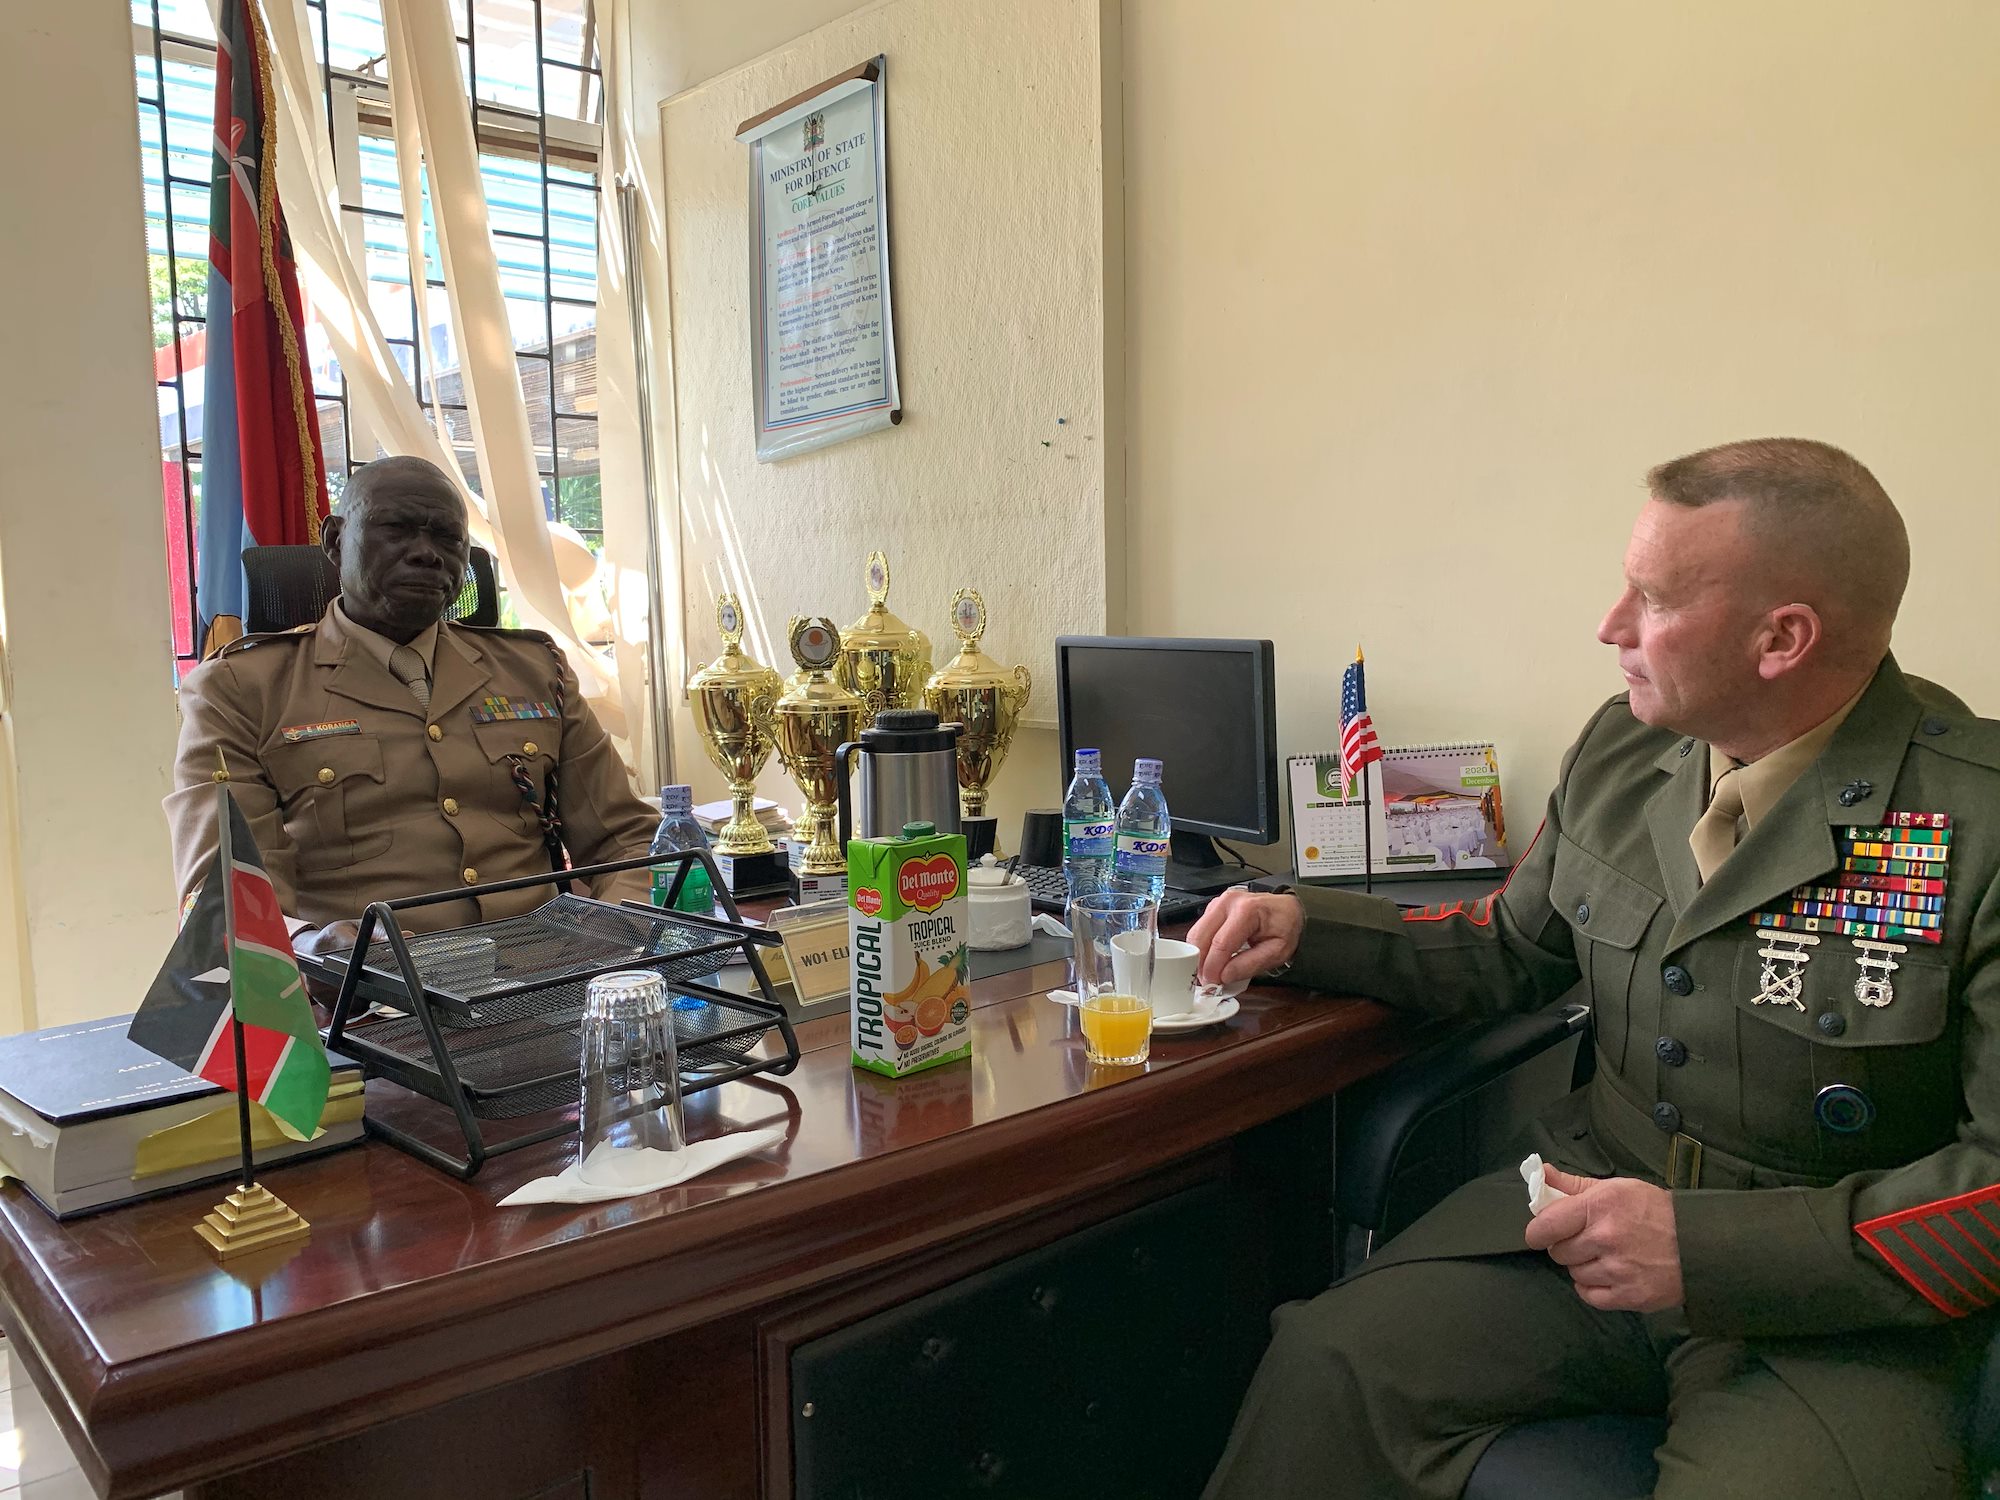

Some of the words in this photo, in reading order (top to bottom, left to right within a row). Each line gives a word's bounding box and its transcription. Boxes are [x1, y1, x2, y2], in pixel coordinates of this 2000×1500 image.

[770, 155, 812, 184] MINISTRY
[818, 147, 830, 162] OF
[836, 133, 866, 156] STATE
[785, 176, 802, 194] FOR
[806, 158, 850, 187] DEFENCE
[792, 196, 812, 214] CORE
[815, 184, 845, 204] VALUES
[863, 224, 875, 233] shall
[863, 234, 875, 244] Civil
[862, 292, 878, 302] Kenya
[866, 358, 880, 367] based
[871, 366, 880, 374] will
[868, 378, 880, 386] other
[316, 720, 356, 732] KORANGA
[1132, 841, 1168, 853] KDF
[902, 875, 918, 890] Del
[920, 869, 954, 888] Monte
[866, 896, 881, 905] Monte
[916, 889, 940, 900] Quality
[908, 916, 956, 942] TROPICAL
[914, 940, 930, 948] JUICE
[932, 936, 952, 944] BLEND
[801, 952, 828, 967] WO1
[857, 922, 884, 1050] TROPICAL
[904, 1060, 910, 1068] NO
[911, 1047, 940, 1065] PRESERVATIVES
